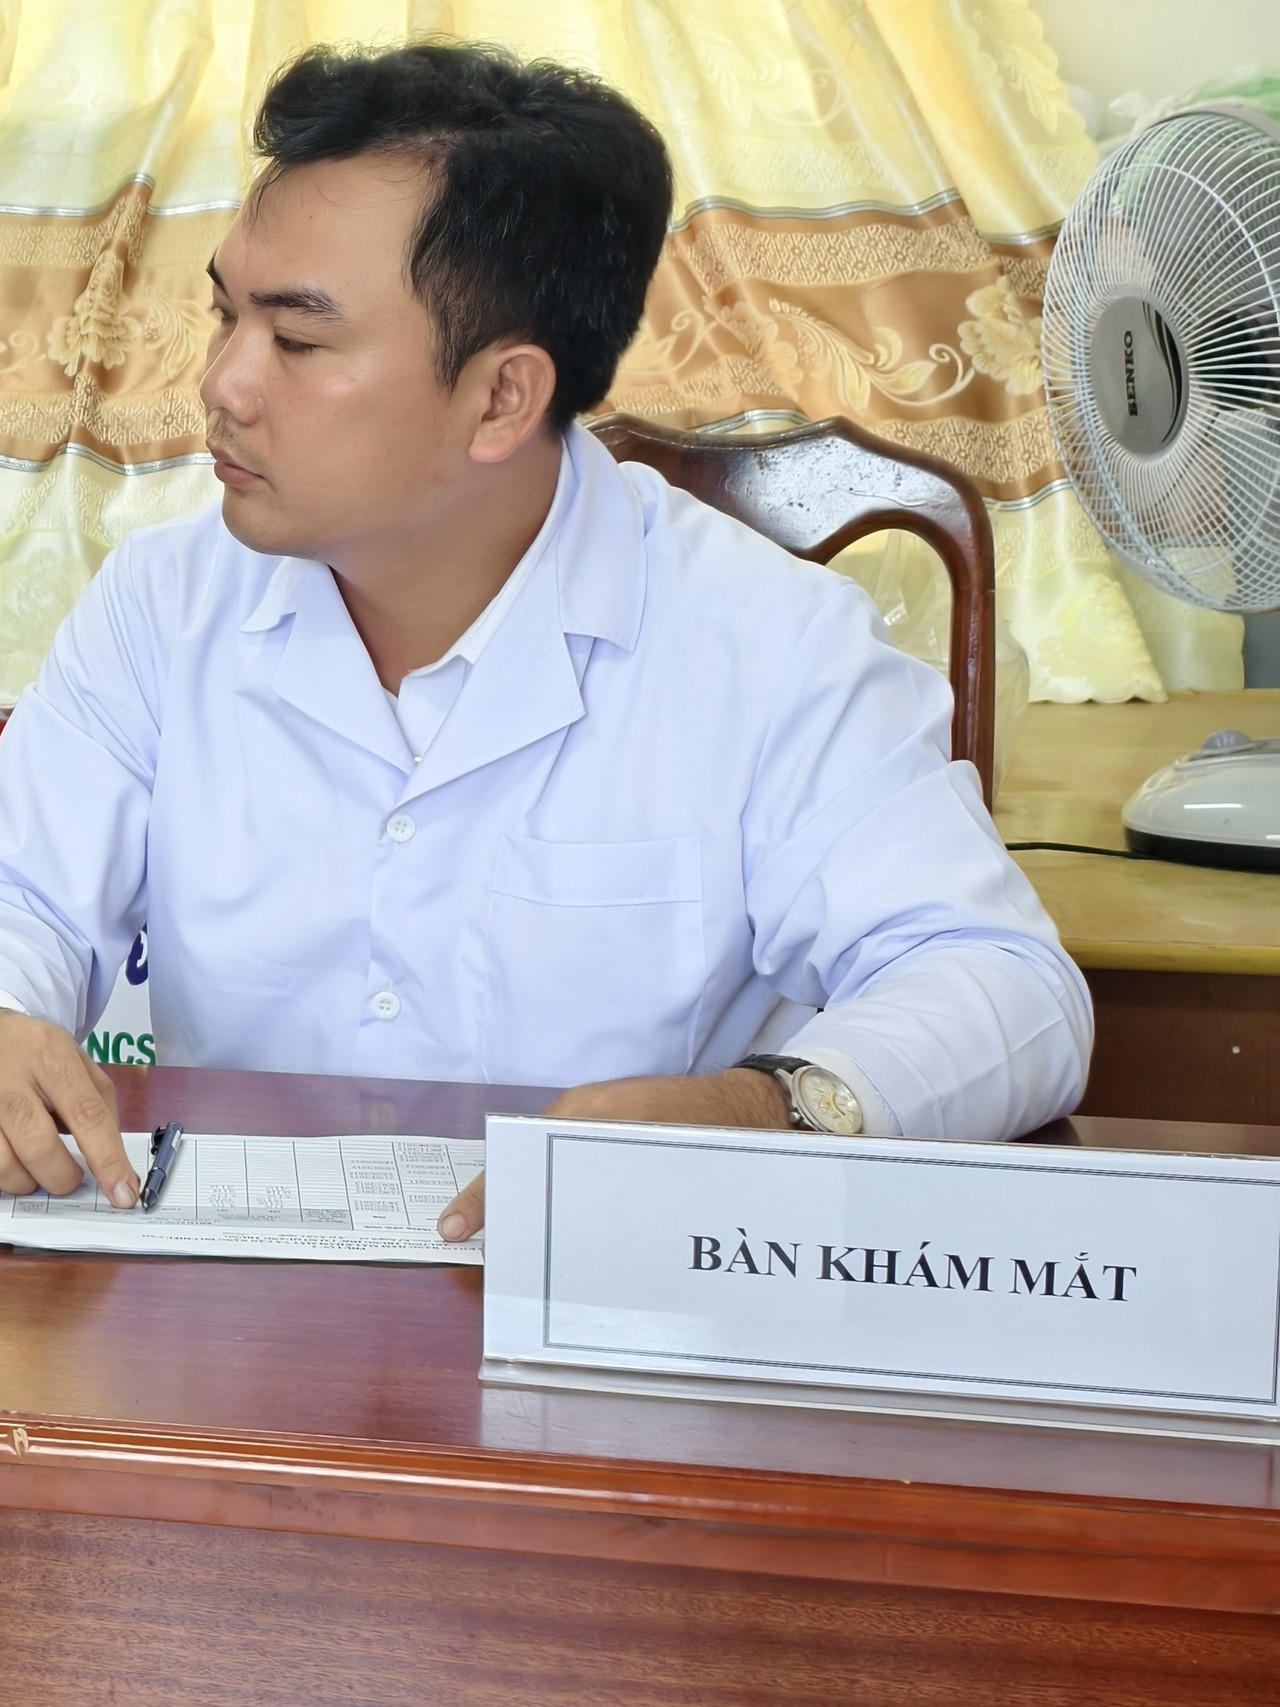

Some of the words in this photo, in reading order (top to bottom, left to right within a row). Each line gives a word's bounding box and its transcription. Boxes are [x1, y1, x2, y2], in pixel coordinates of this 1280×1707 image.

[1123, 330, 1138, 416] SENKO
[688, 1227, 802, 1278] BÀN
[816, 1241, 995, 1293] KHÁM
[1008, 1251, 1138, 1302] MẮT
